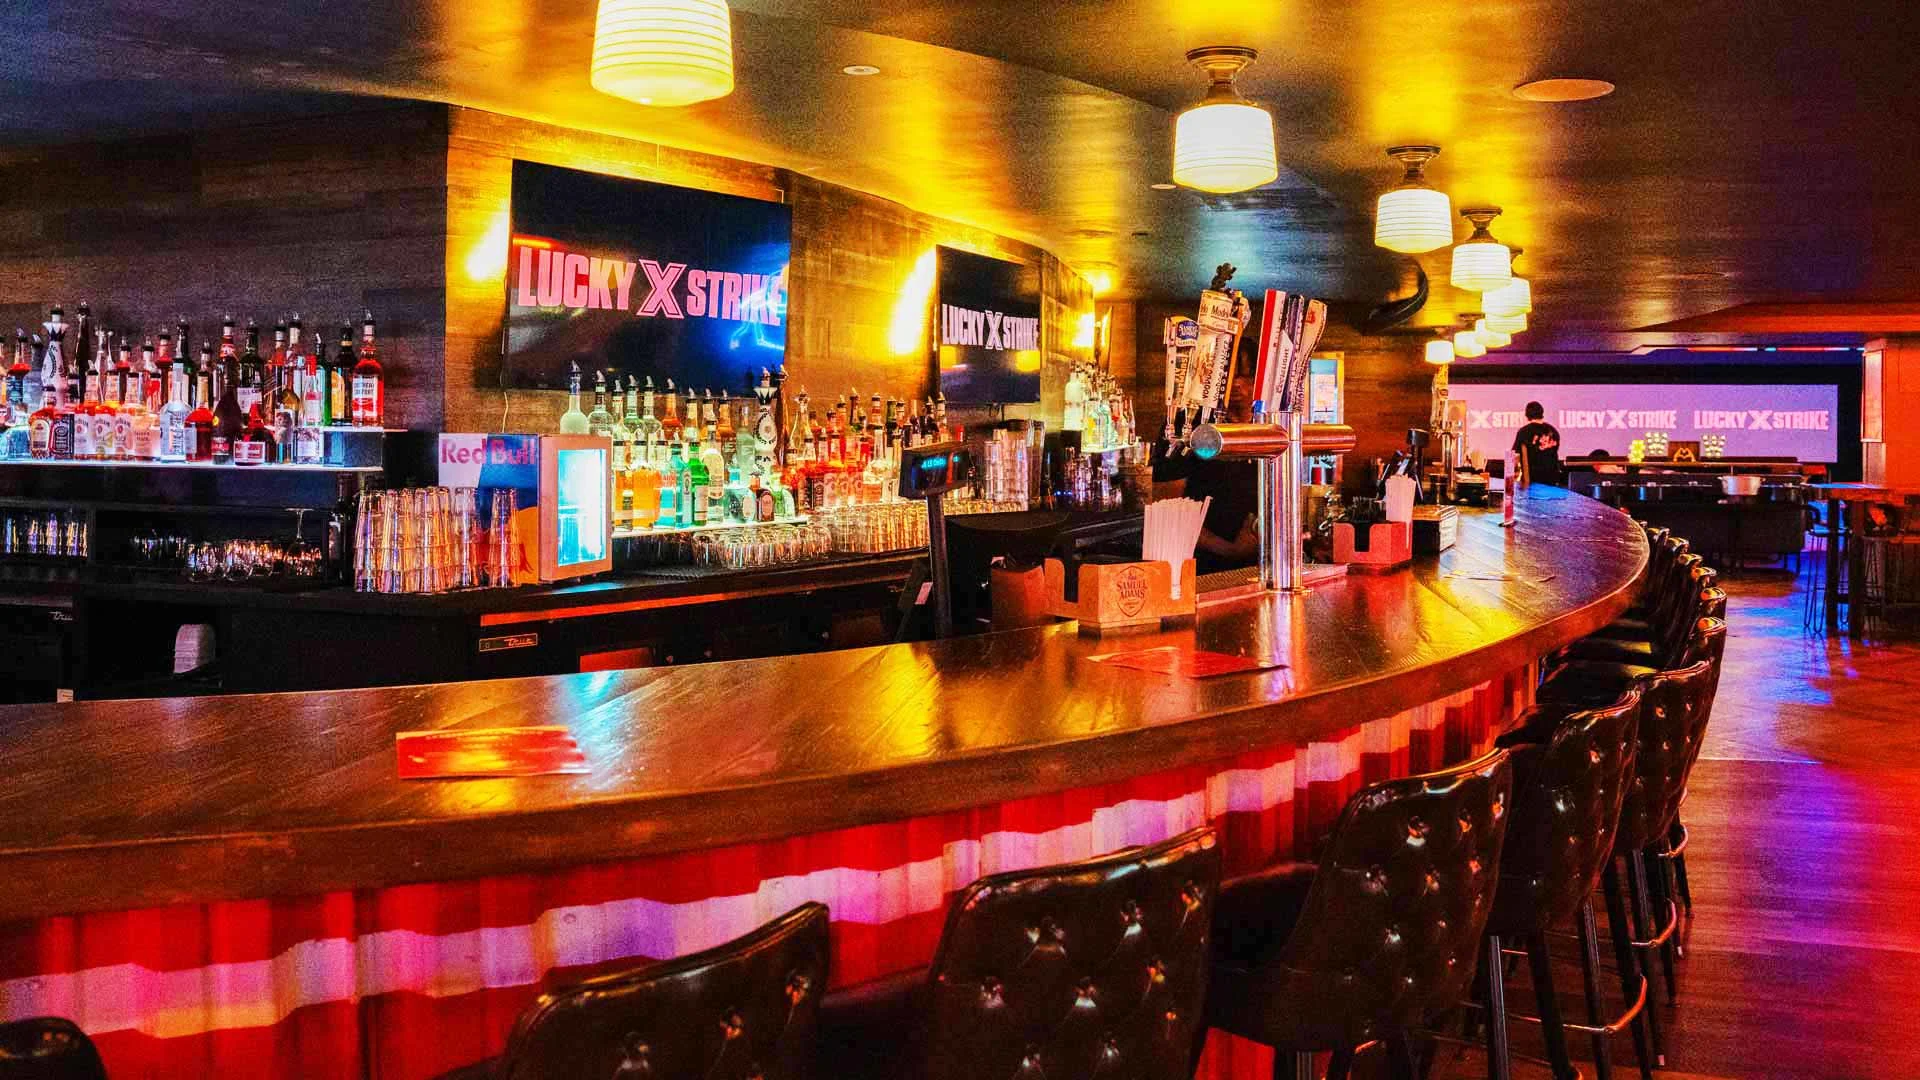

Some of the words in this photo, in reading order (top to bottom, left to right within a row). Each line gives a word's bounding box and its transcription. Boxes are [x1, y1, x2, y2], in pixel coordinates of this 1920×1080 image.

[517, 246, 637, 311] LUCKY
[636, 258, 687, 319] X
[686, 269, 784, 326] STRIKE
[942, 303, 985, 346] LUCKY
[985, 309, 1003, 350] X
[1003, 315, 1039, 350] STRIKE
[1492, 411, 1524, 429] STRI
[1559, 410, 1605, 429] LUCKY
[1606, 409, 1628, 430] X
[1628, 410, 1677, 429] STRIKE
[1694, 410, 1747, 430] LUCKY
[1748, 410, 1773, 430] X
[1773, 411, 1829, 430] STRIKE
[441, 438, 487, 465] Red
[491, 438, 536, 465] Bull
[1116, 579, 1148, 592] SAMUEL
[1119, 589, 1145, 600] ADAMS
